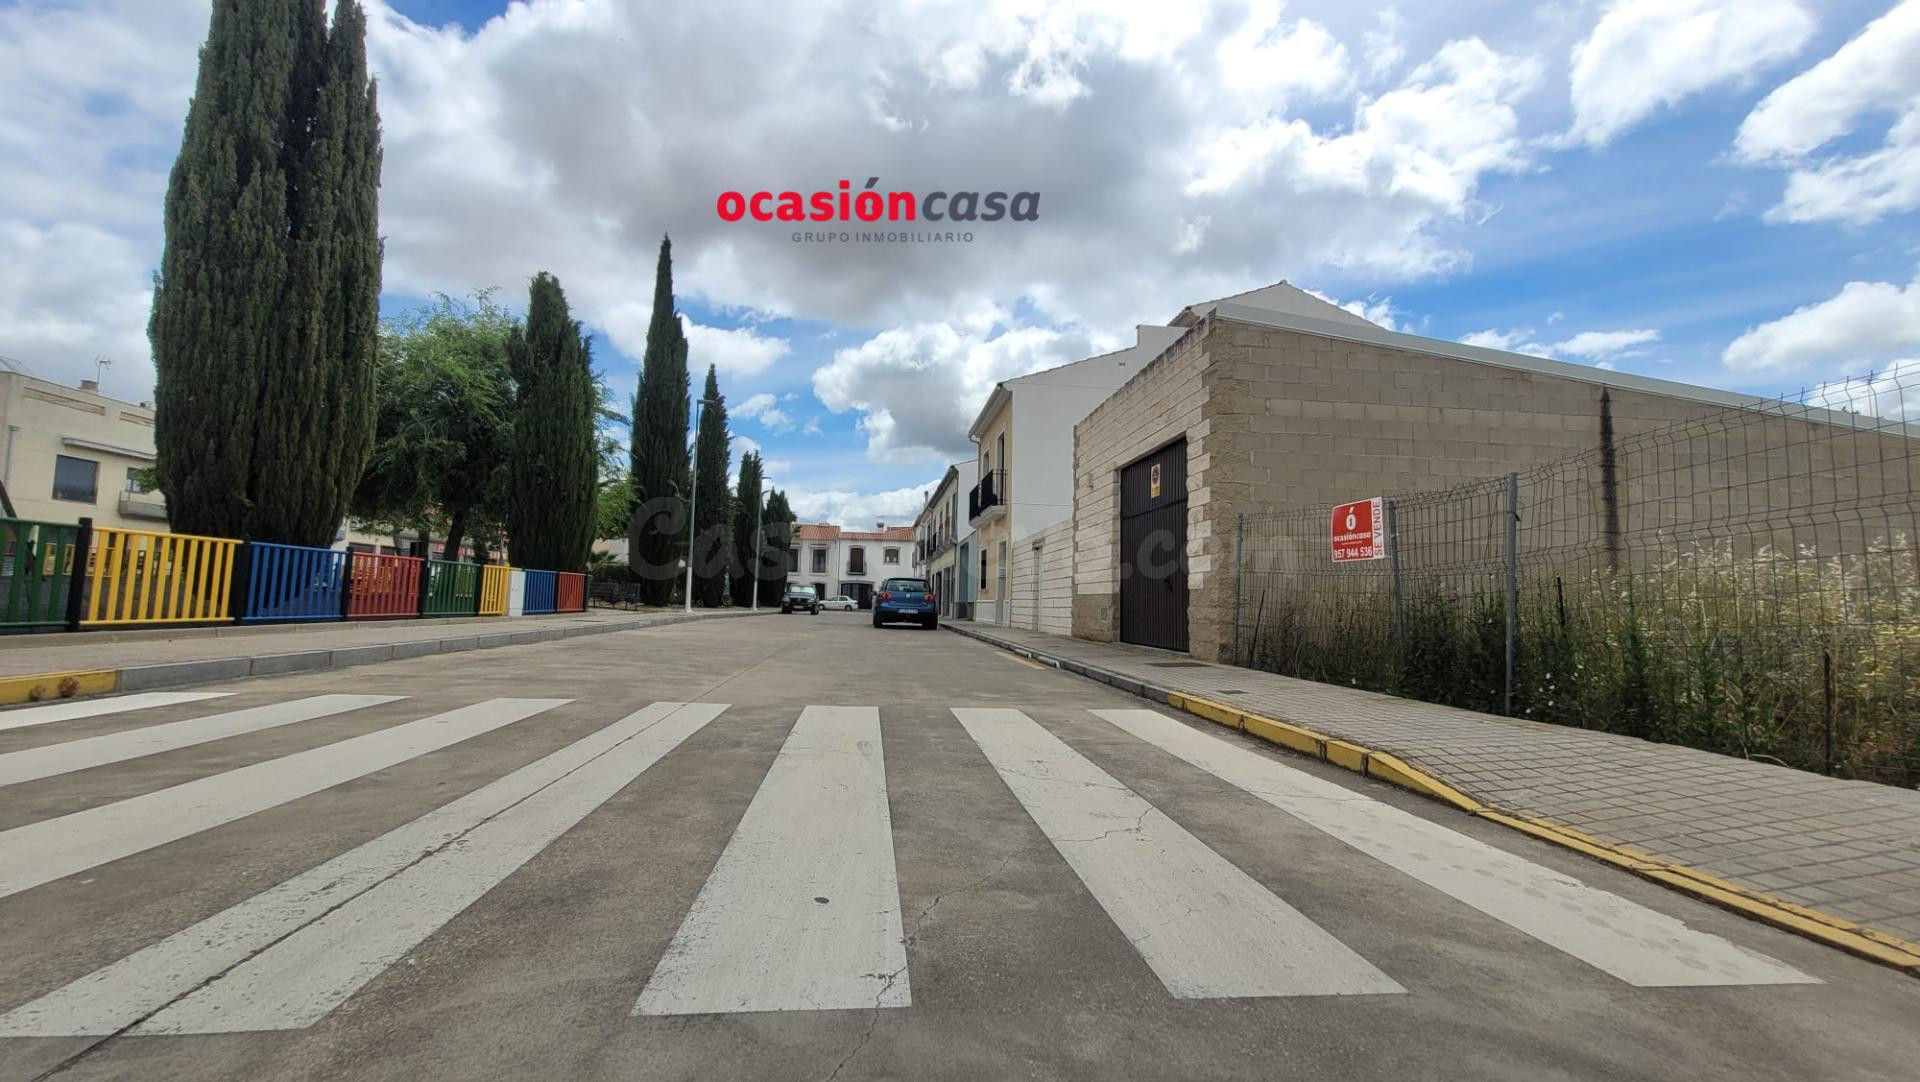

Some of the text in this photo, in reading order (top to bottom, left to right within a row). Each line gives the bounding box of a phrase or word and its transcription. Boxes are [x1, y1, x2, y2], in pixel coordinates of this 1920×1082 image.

[1373, 500, 1383, 556] SE VENDE
[1334, 548, 1345, 559] 957
[1346, 547, 1358, 558] 944
